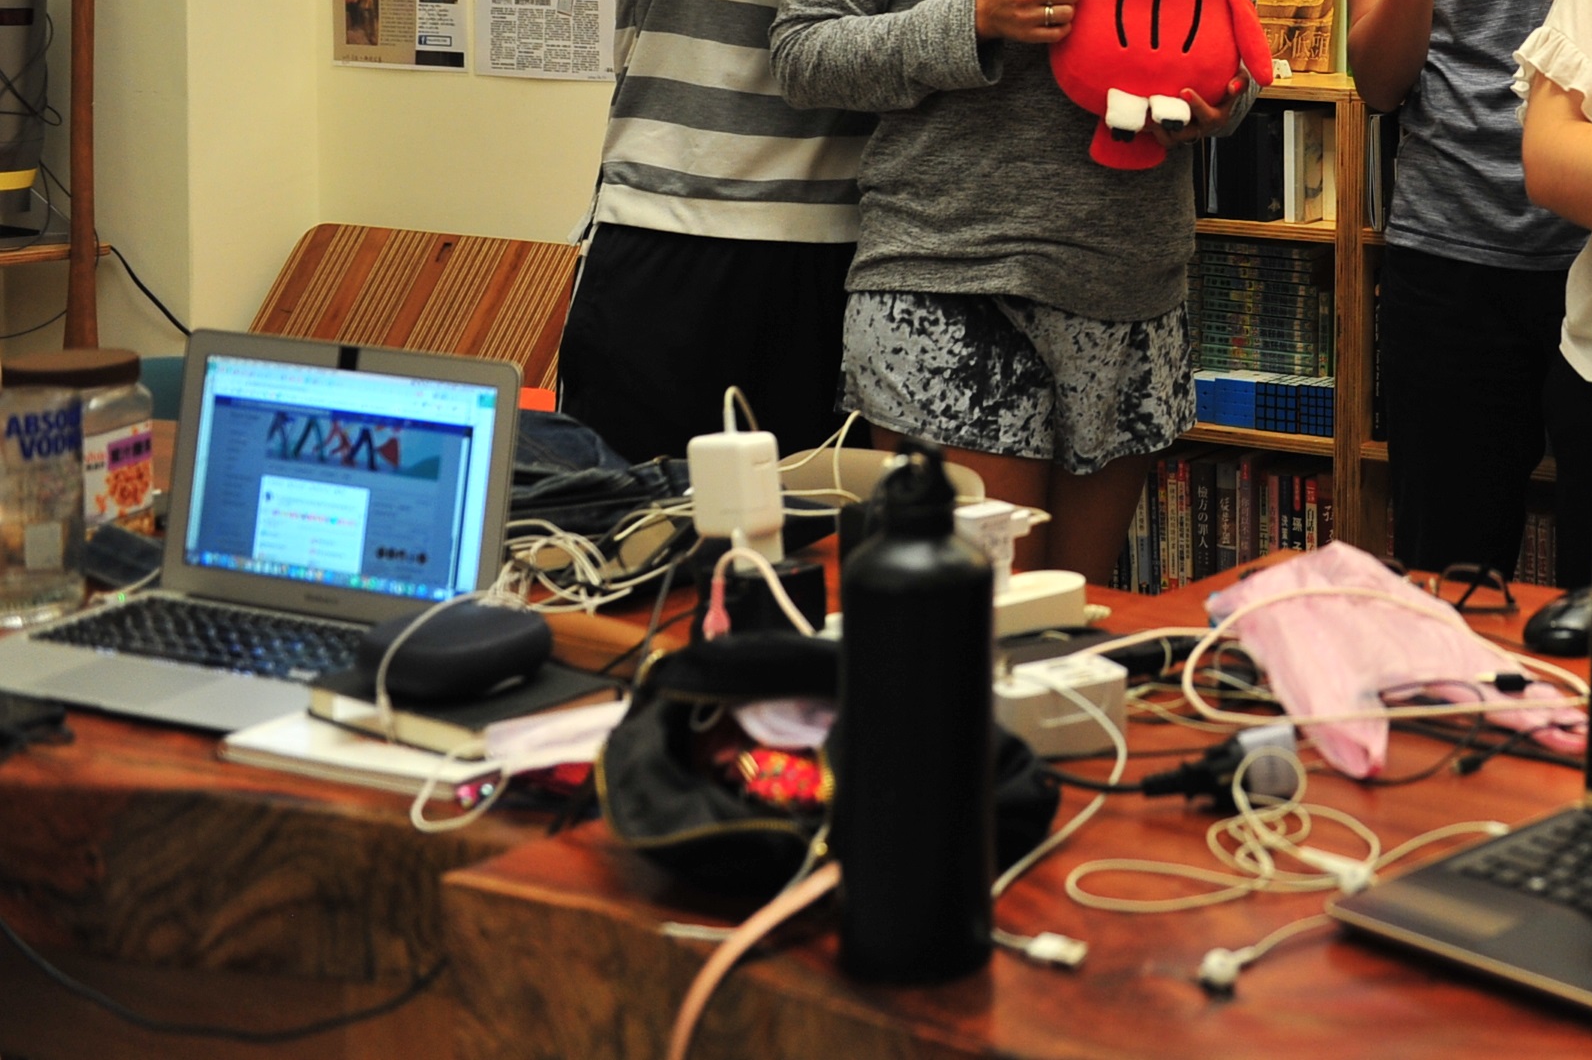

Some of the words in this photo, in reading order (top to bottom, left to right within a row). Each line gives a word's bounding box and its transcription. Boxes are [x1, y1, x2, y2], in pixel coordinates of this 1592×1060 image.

[1197, 484, 1209, 549] 檢方の罪人
